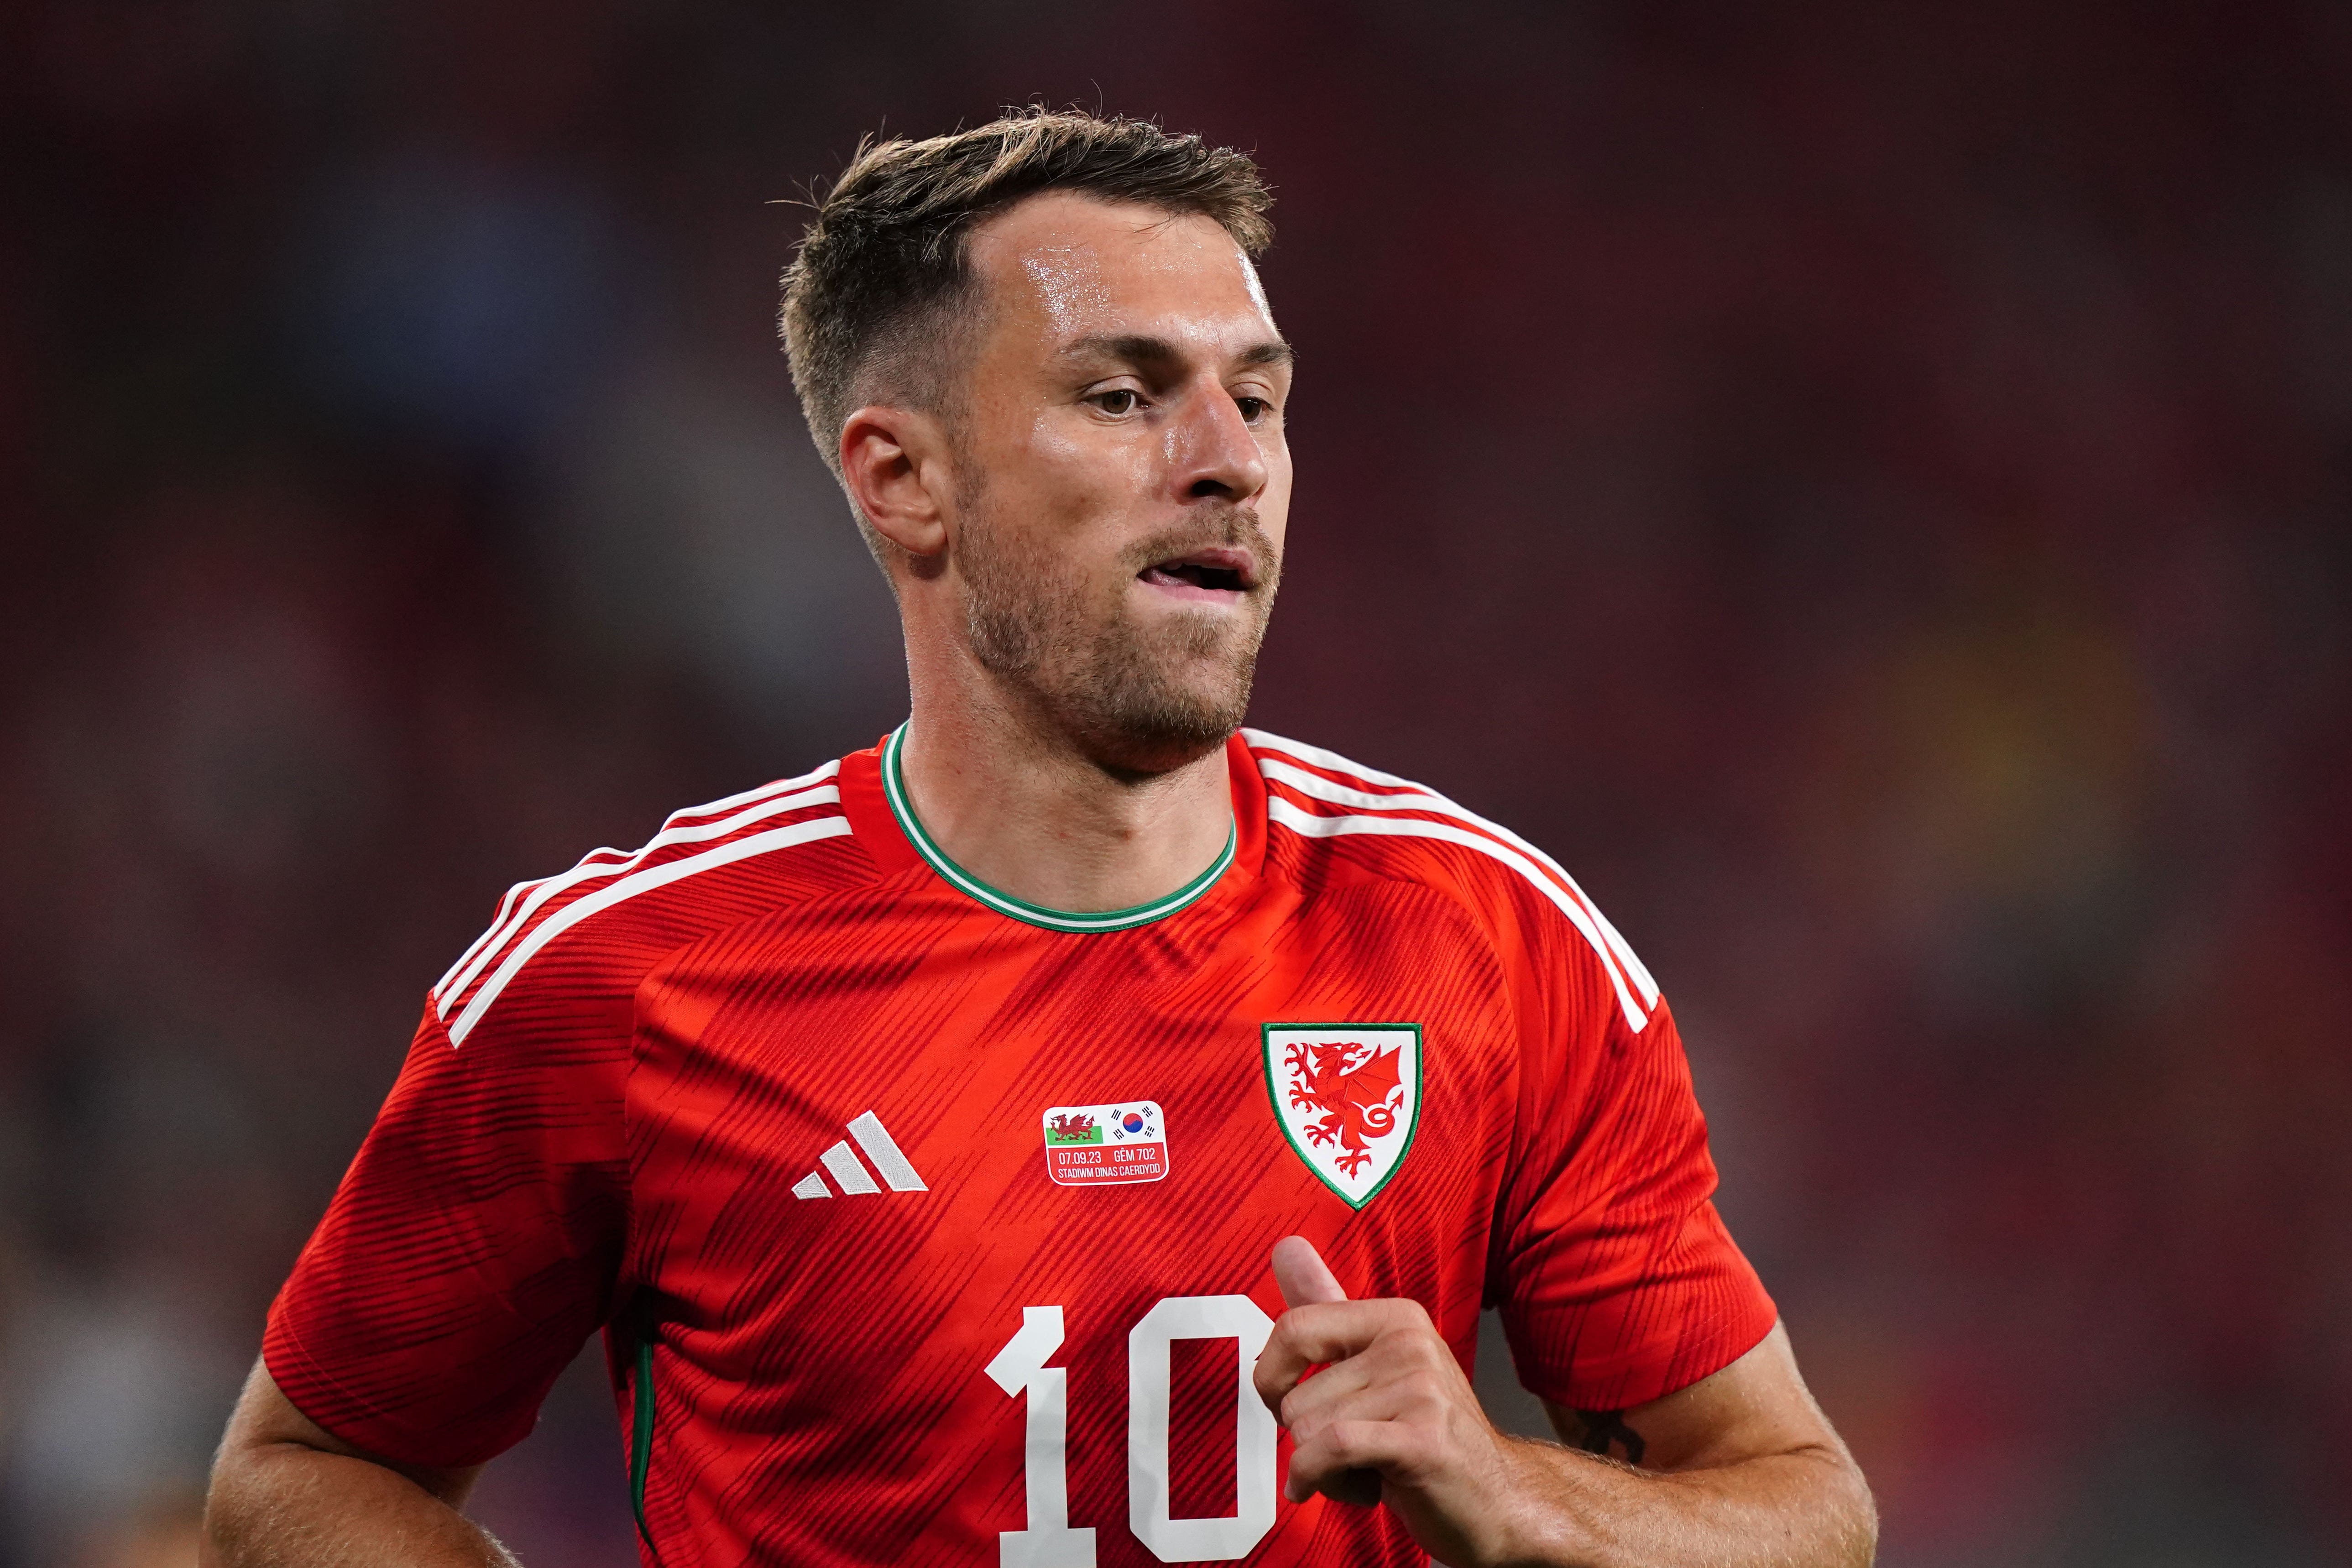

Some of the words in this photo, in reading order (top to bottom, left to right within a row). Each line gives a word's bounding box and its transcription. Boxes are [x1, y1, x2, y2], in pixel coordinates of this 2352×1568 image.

[1058, 1151, 1102, 1165] 07.09.23
[1113, 1147, 1134, 1162] GÊM
[1136, 1147, 1155, 1160] 702
[1058, 1167, 1093, 1178] STADIWM
[1095, 1166, 1118, 1177] DINAS
[1119, 1163, 1160, 1176] CAERDYDD
[984, 1294, 1277, 1568] 10
